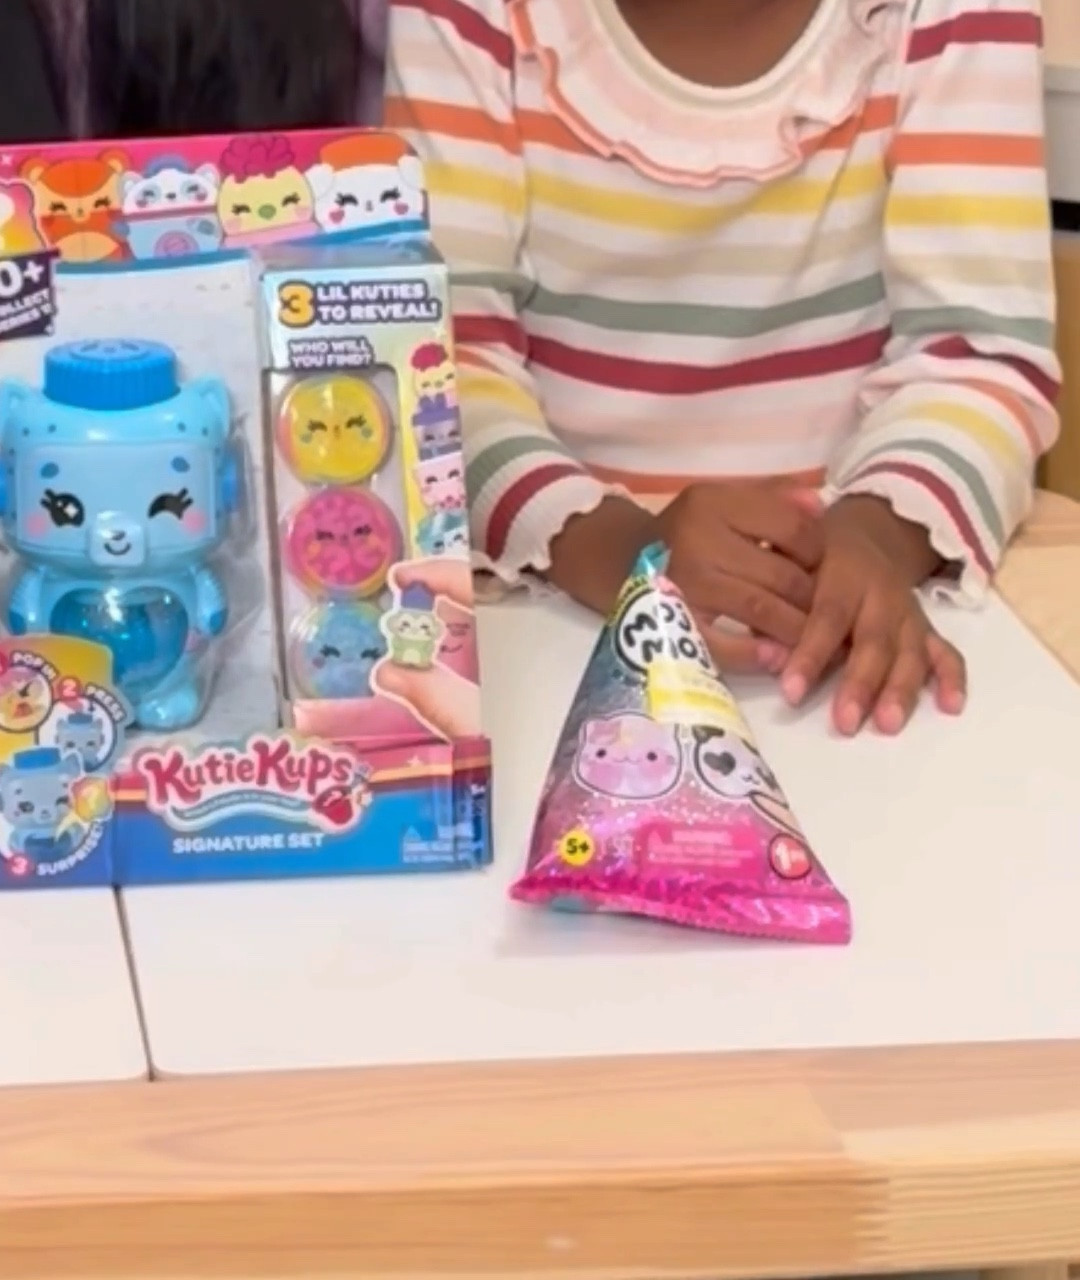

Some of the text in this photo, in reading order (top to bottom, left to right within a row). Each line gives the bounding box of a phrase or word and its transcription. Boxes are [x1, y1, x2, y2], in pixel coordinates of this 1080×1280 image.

[279, 282, 425, 326] 3 LIL KUTIES
[317, 301, 439, 321] TO REVEAL!
[290, 339, 370, 354] WHO WILL
[292, 353, 372, 368] YOU FIND?
[62, 679, 78, 696] 2
[144, 738, 353, 805] KutieKups
[173, 832, 326, 854] SIGNATURE SET
[565, 838, 590, 855] 5+
[10, 856, 28, 875] 3
